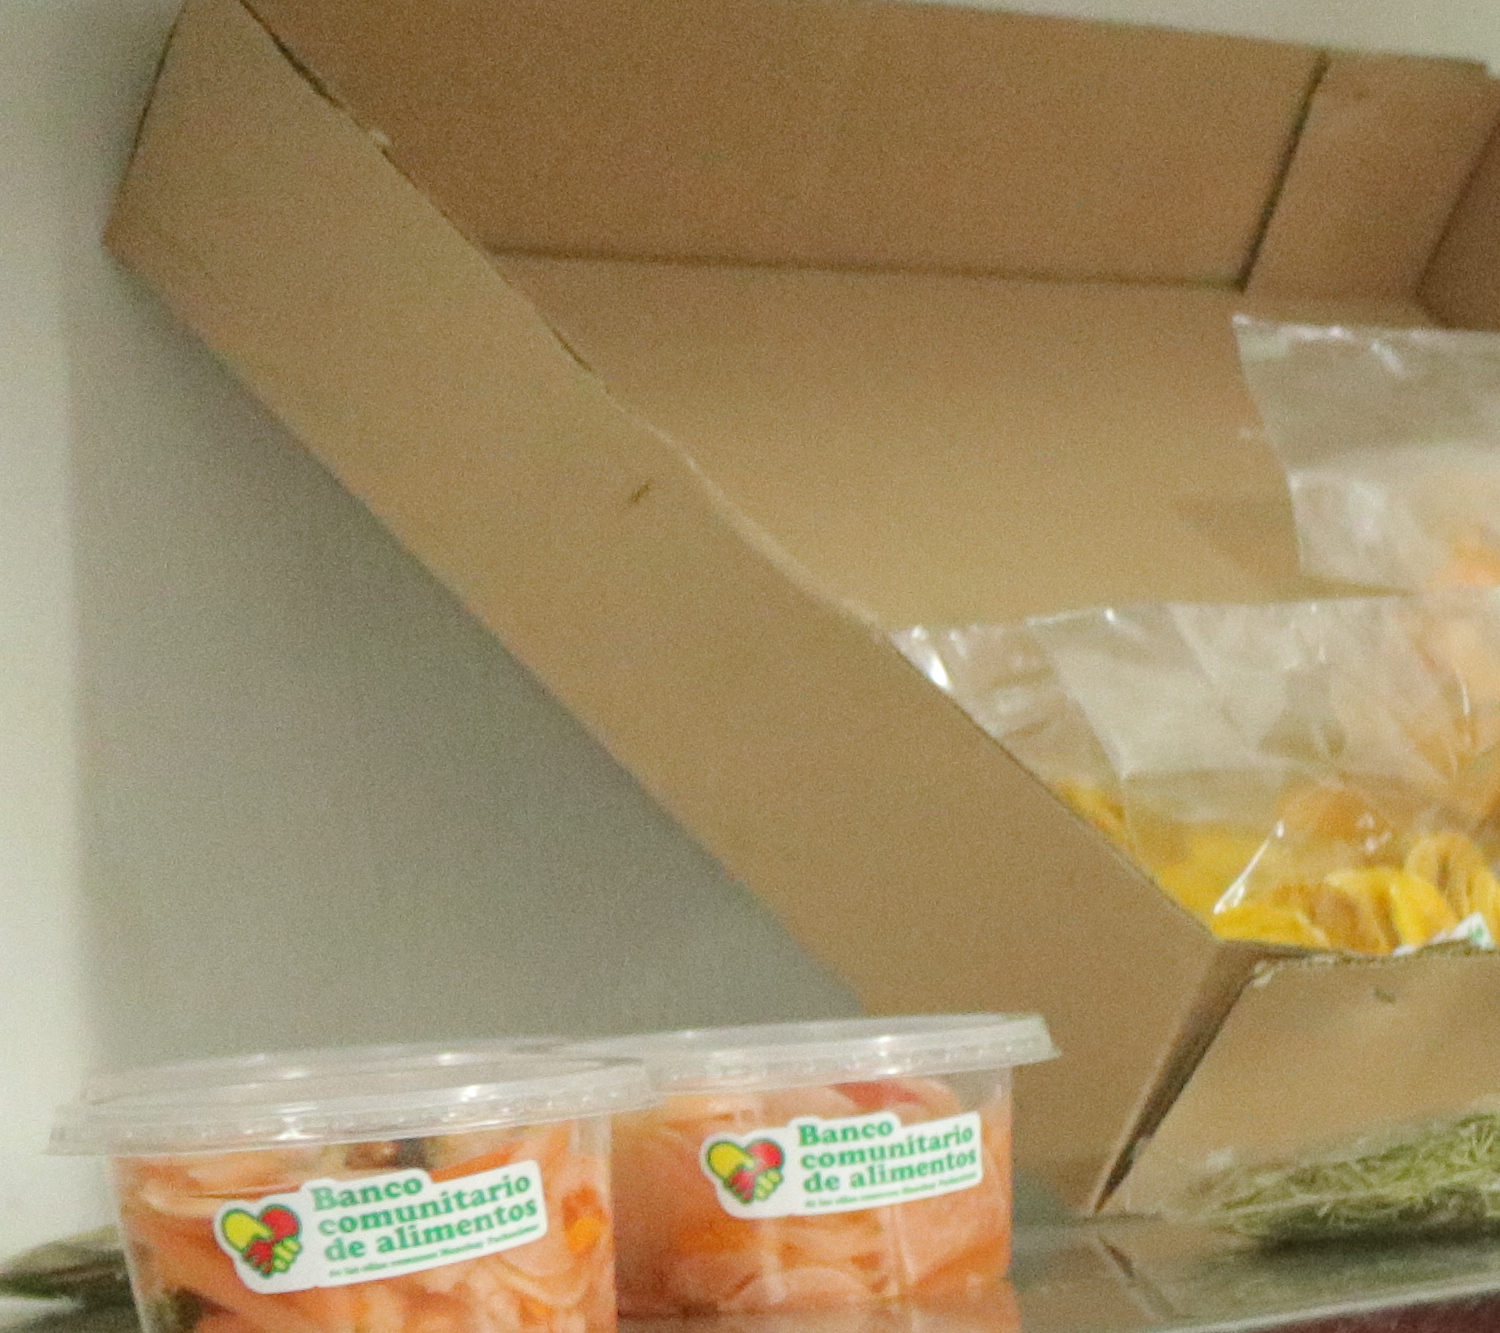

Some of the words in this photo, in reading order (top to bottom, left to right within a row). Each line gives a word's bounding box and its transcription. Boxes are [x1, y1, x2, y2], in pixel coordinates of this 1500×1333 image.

[799, 1120, 893, 1147] Banco
[801, 1125, 974, 1170] comunitario
[804, 1171, 841, 1193] de
[850, 1149, 977, 1189] alimentos
[311, 1177, 423, 1211] Banco
[318, 1175, 531, 1236] comunitario
[325, 1236, 366, 1263] de
[376, 1198, 538, 1254] alimentos
